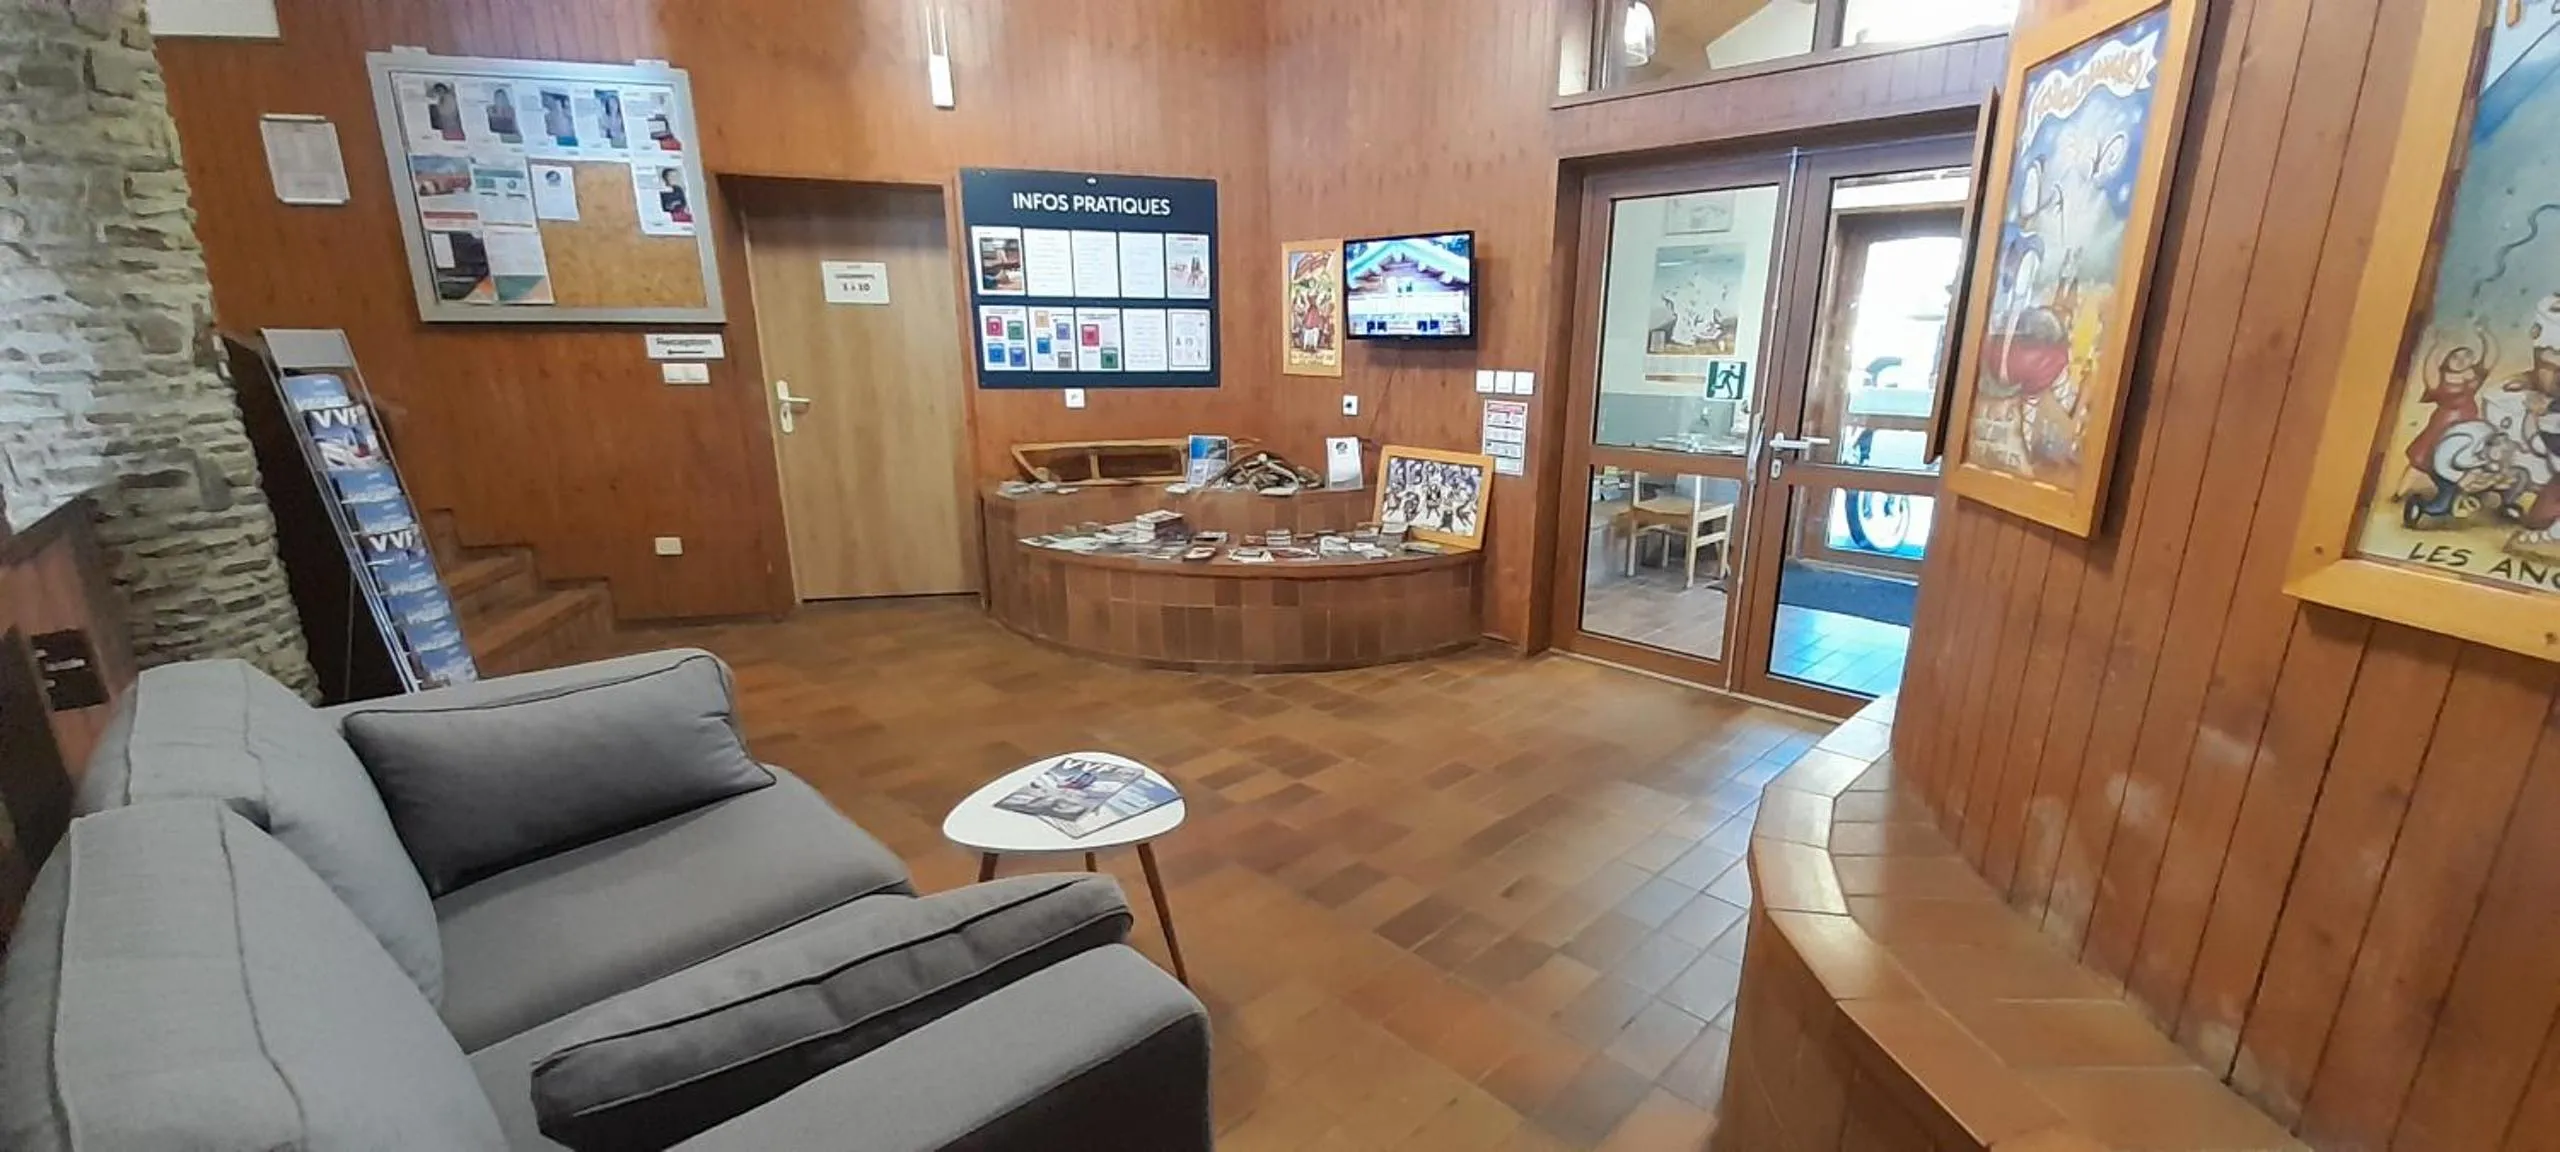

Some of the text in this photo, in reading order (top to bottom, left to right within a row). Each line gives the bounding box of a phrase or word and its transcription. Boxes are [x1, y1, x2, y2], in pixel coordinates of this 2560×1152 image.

[1012, 192, 1171, 215] INFOS PRATIQUES
[2407, 542, 2472, 566] LES
